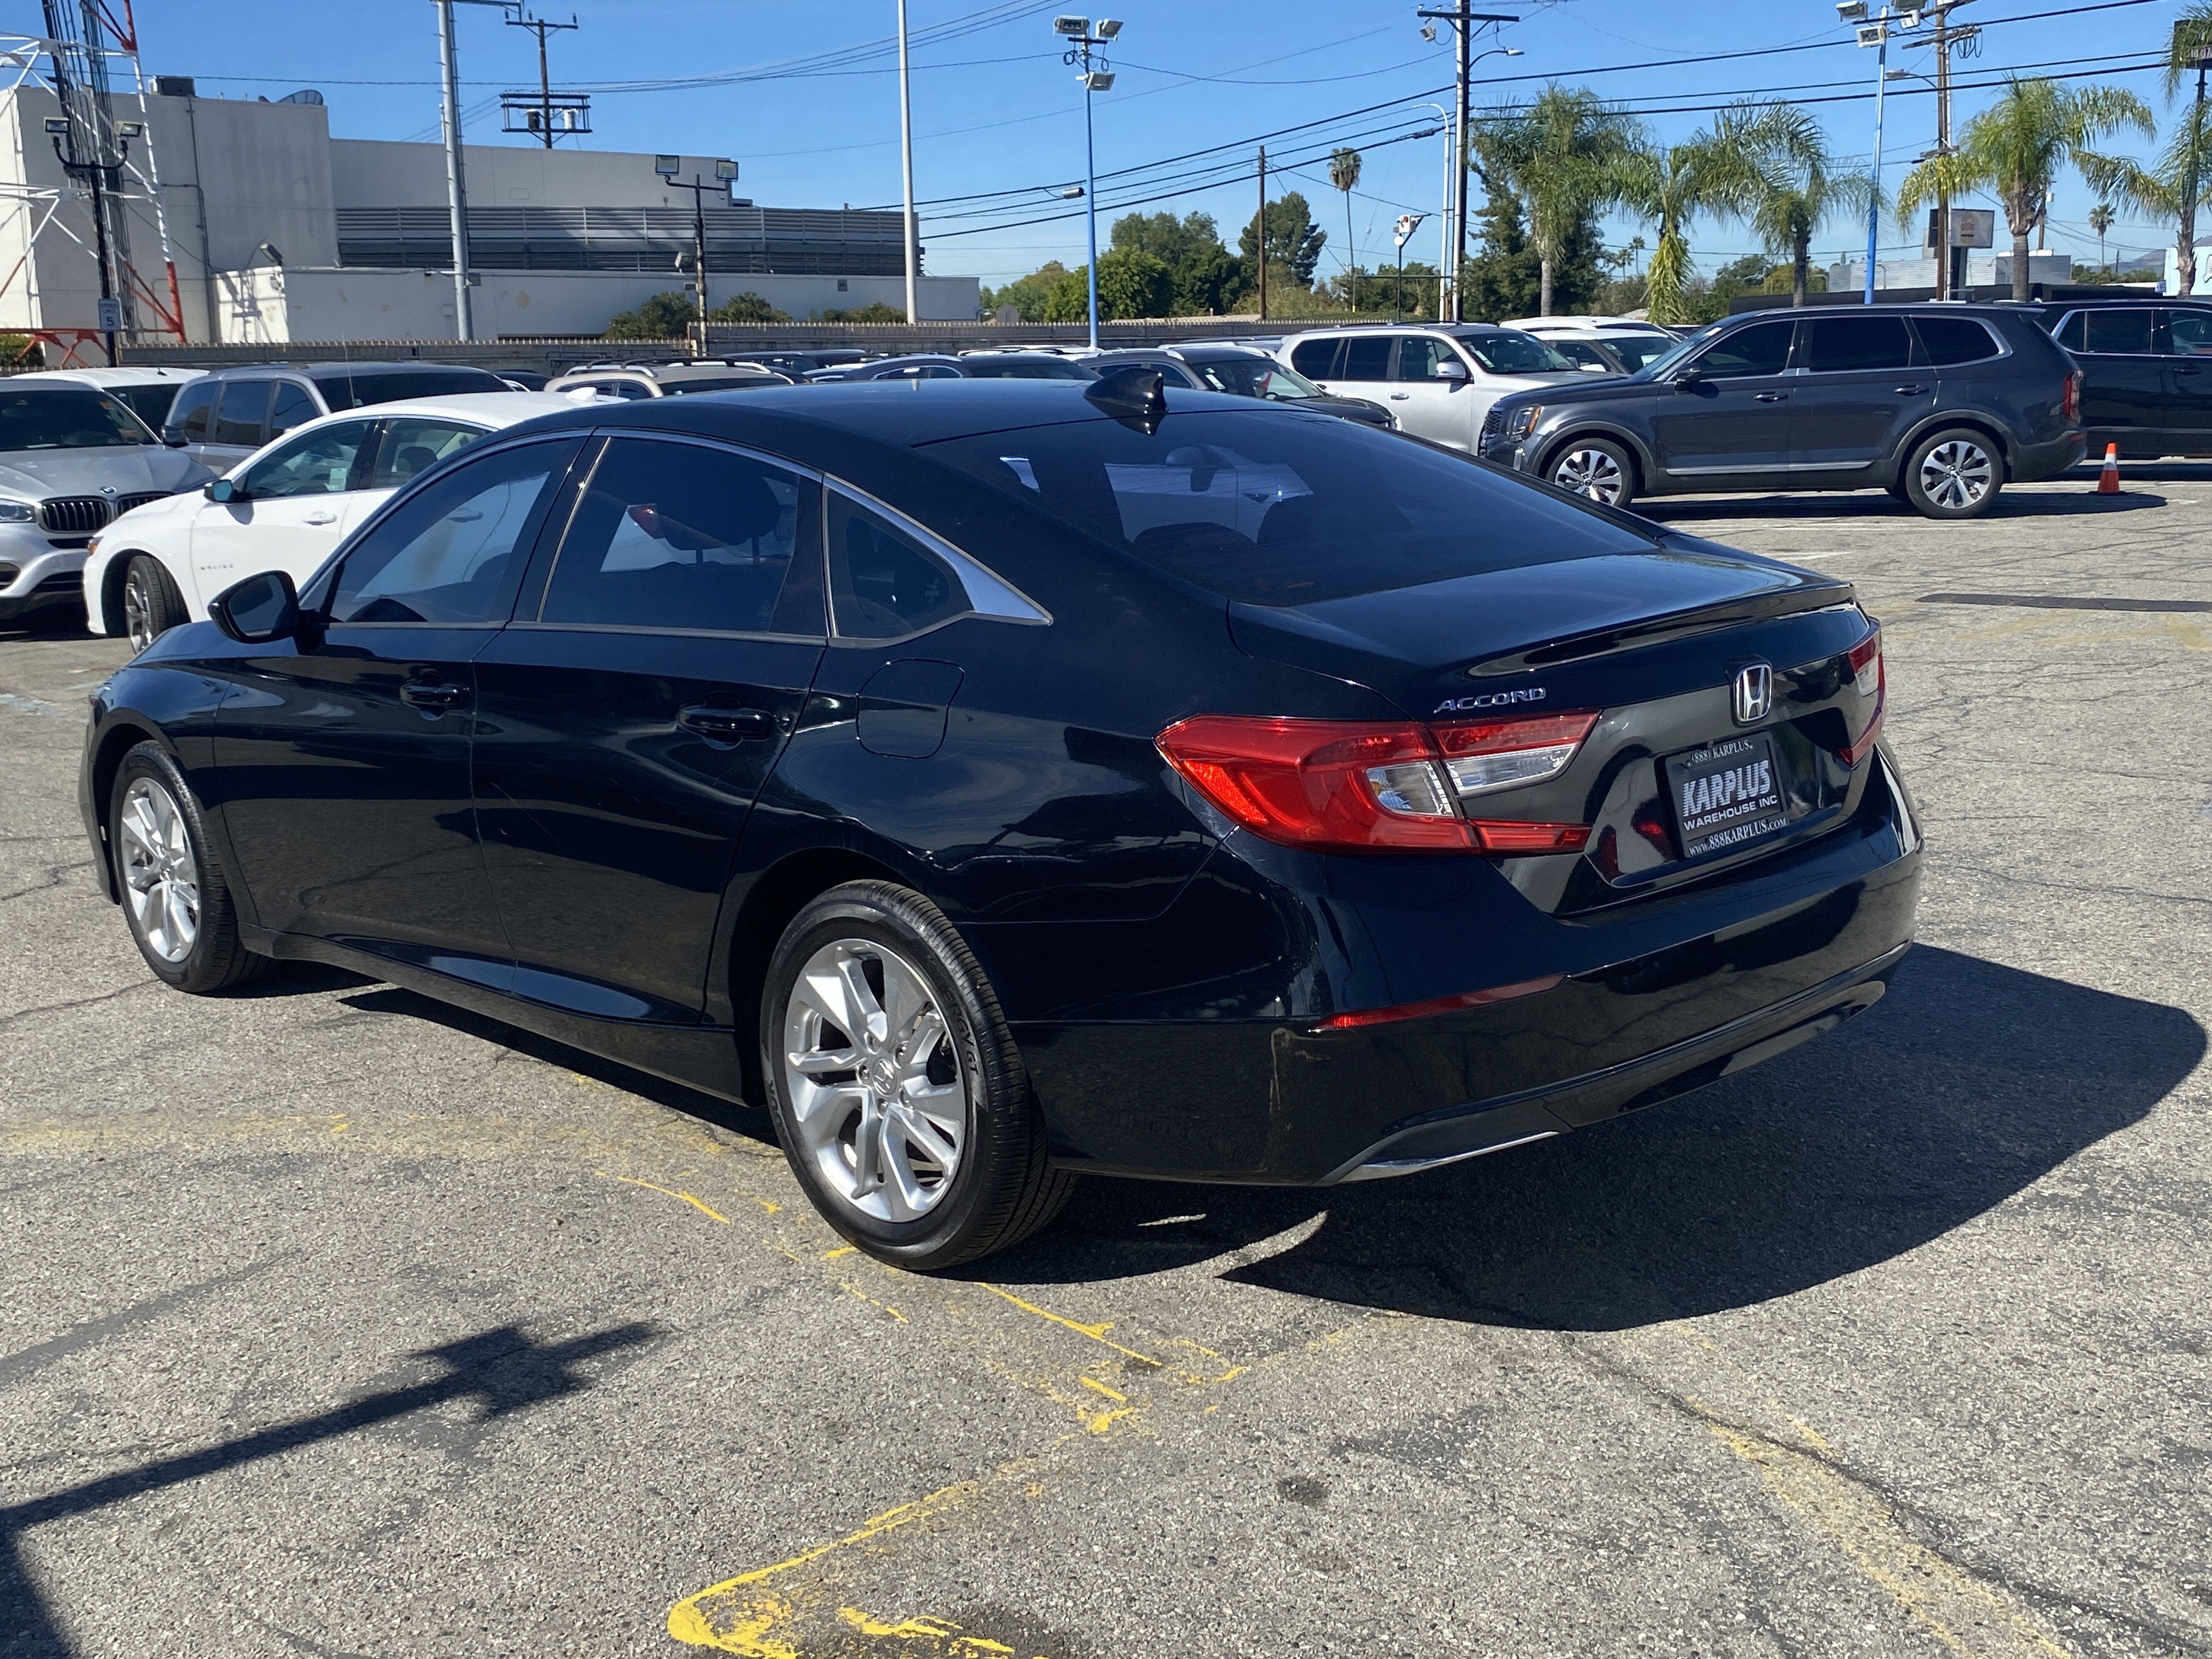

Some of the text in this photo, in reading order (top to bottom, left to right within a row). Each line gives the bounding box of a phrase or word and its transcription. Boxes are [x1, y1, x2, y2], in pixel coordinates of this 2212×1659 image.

[106, 316, 115, 326] 5
[1433, 687, 1547, 714] ACCORD
[1691, 749, 1711, 763] (888)
[1683, 759, 1770, 817] KARPLUS
[1684, 794, 1778, 831] WAREHOUSE INC
